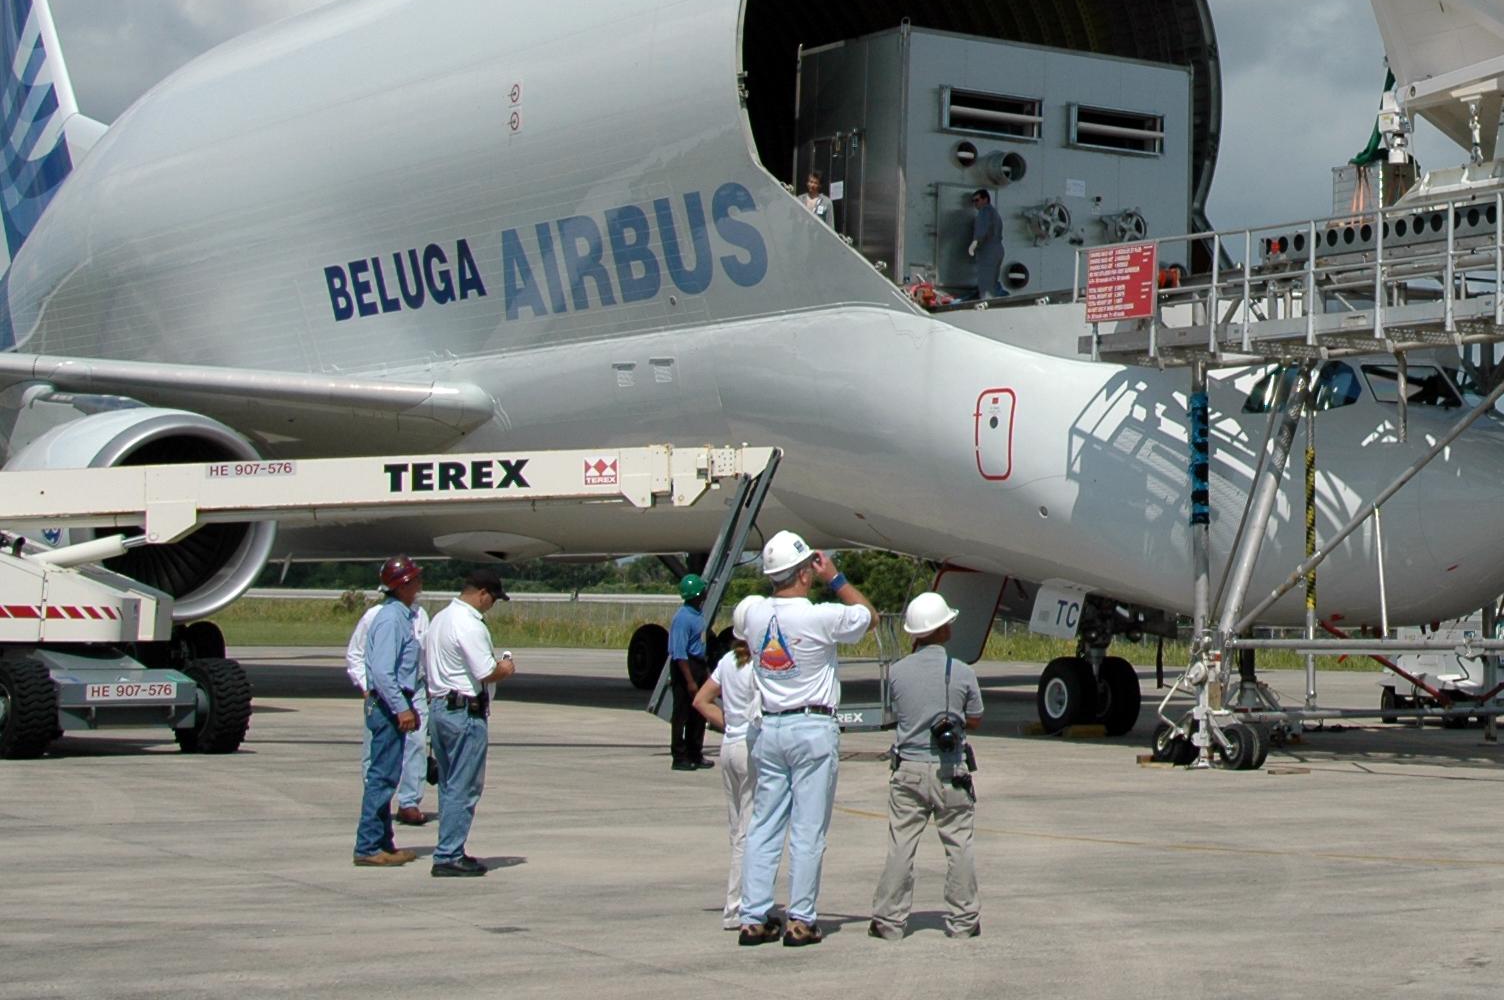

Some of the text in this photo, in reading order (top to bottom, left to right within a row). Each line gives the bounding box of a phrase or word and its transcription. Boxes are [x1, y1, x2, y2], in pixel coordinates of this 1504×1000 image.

[323, 182, 769, 322] BELUGA AIRBUS
[210, 462, 292, 476] HE 907-576
[384, 459, 530, 492] TEREX
[586, 476, 616, 484] TEREX
[1056, 599, 1079, 628] TC
[91, 684, 172, 697] HE 907-576
